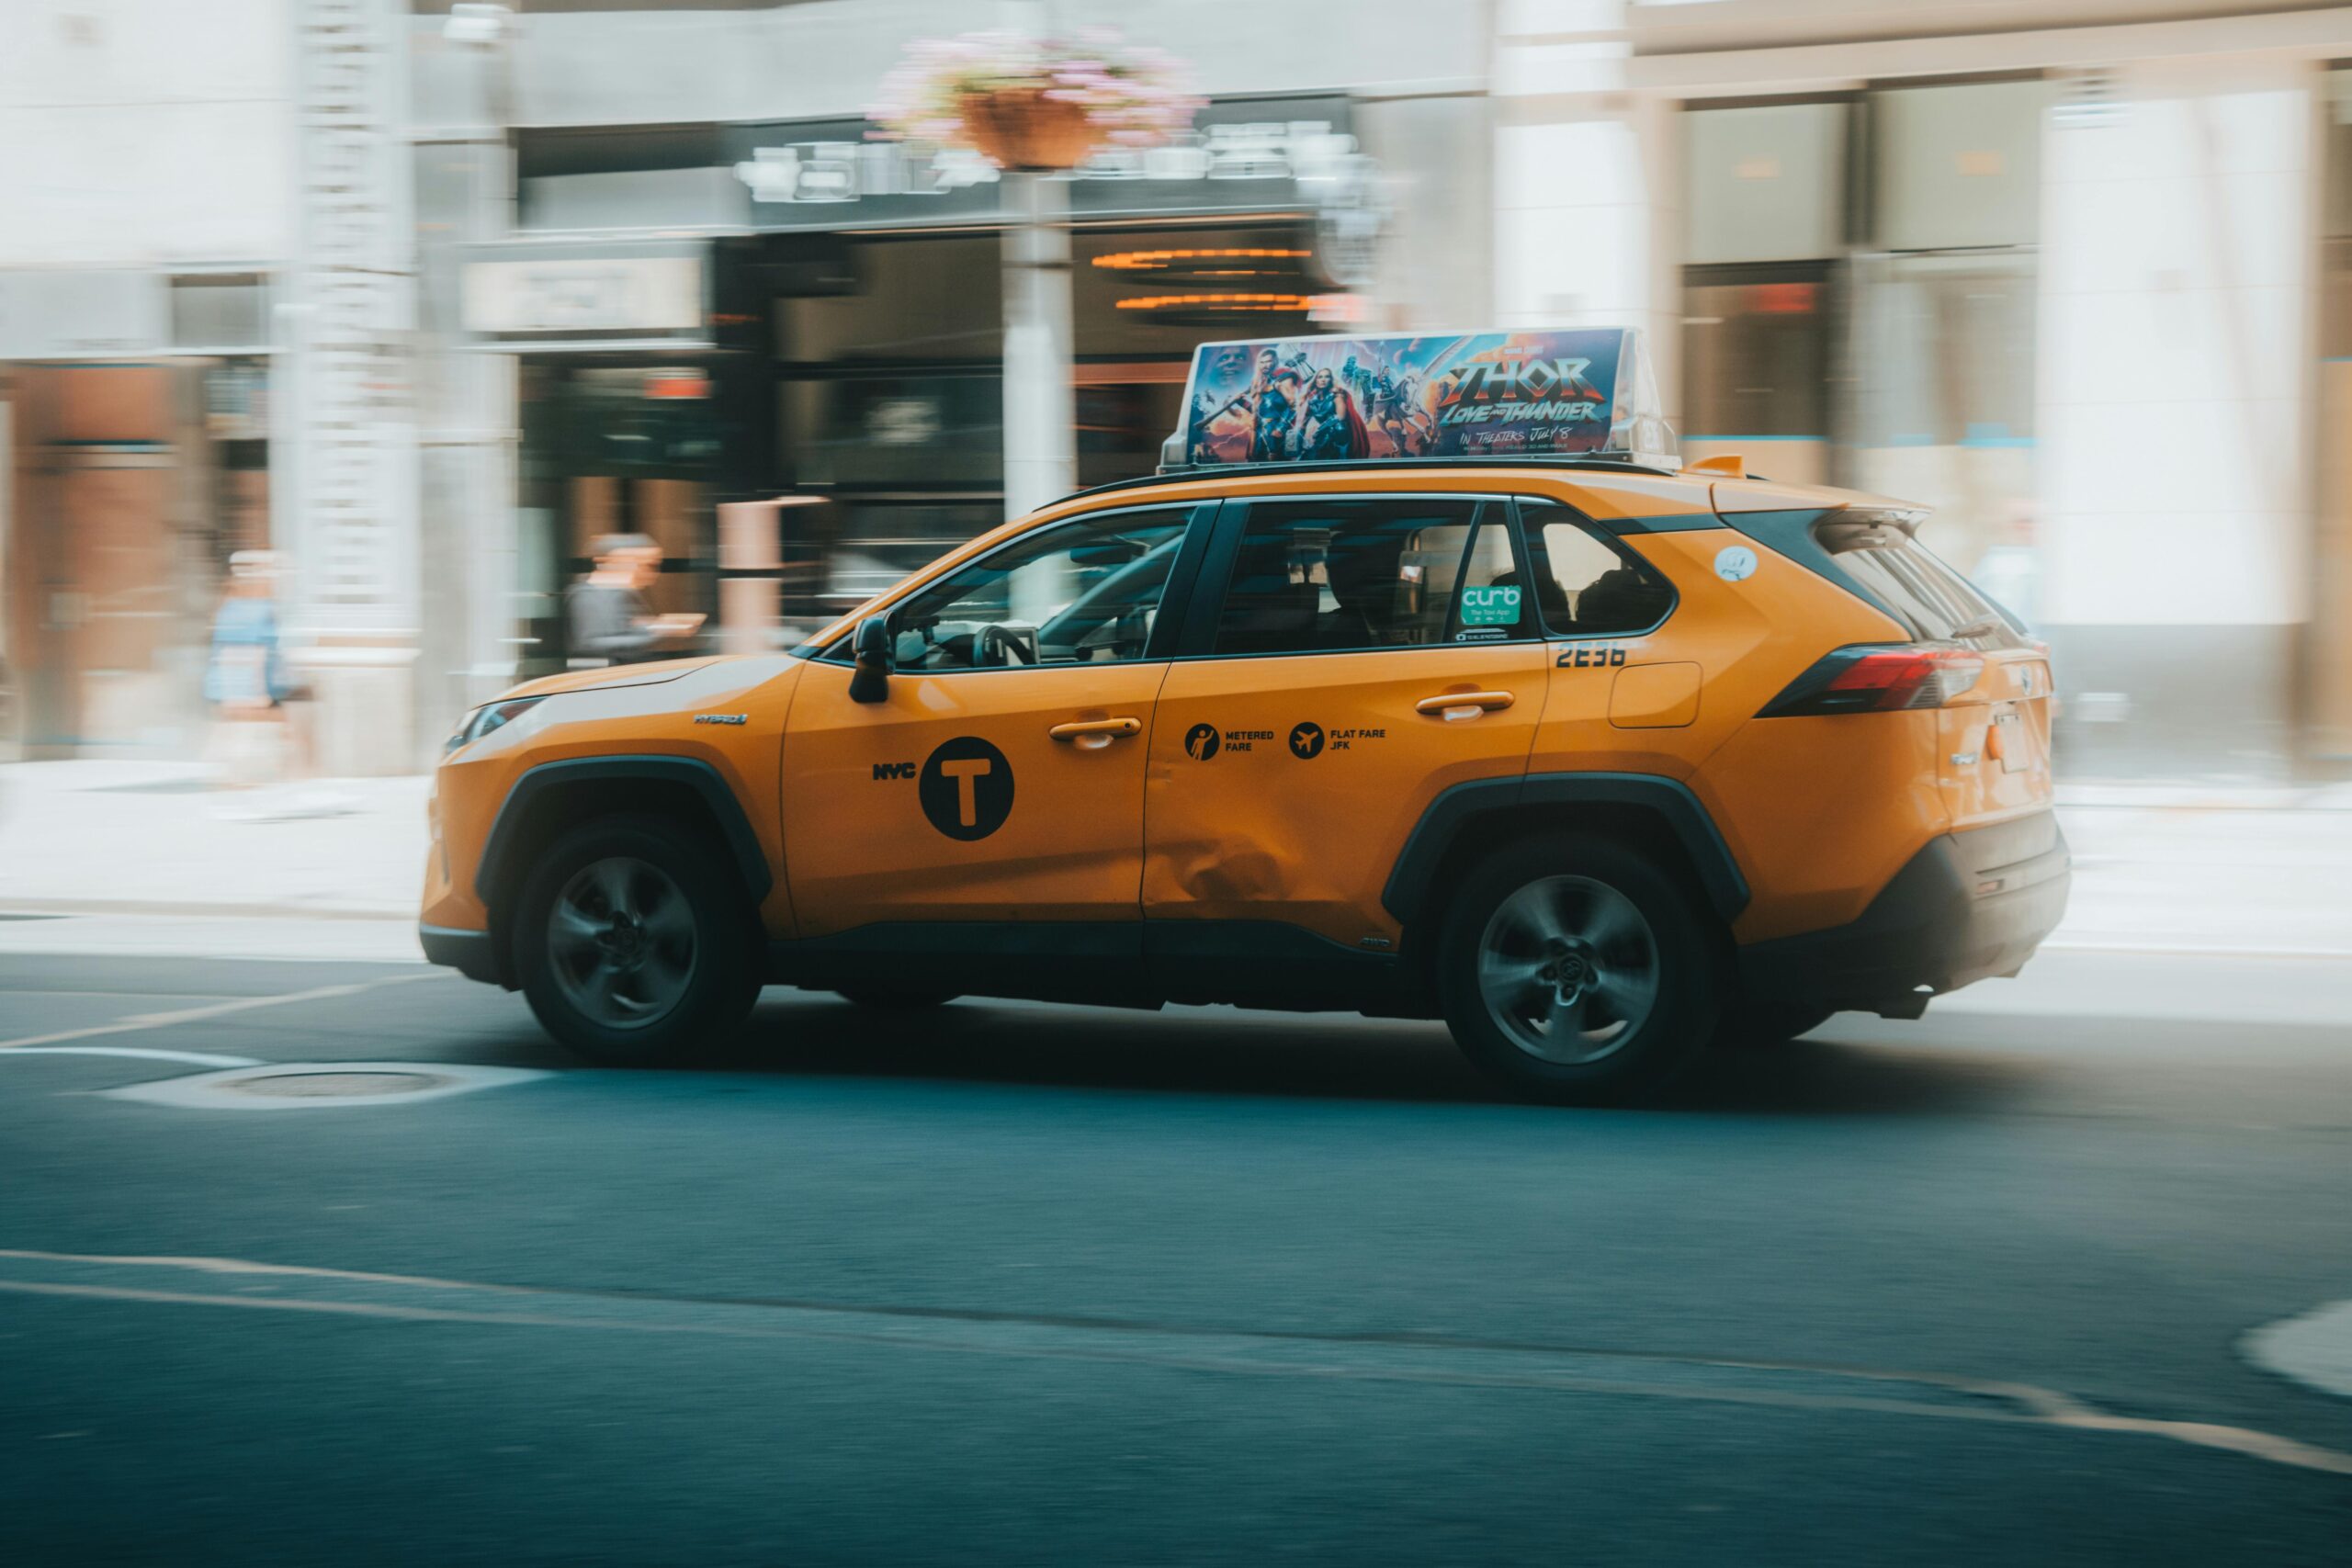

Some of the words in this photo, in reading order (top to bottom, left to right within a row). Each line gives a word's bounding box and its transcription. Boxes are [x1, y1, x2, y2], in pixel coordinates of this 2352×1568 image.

[1440, 357, 1605, 407] THOR
[1439, 403, 1492, 426] LOVE
[1495, 400, 1602, 426] THUNDER
[1459, 433, 1470, 445] IN
[1476, 430, 1525, 445] THEATERS
[1530, 425, 1558, 441] JULY
[1559, 426, 1573, 439] 8
[1463, 587, 1521, 606] curb
[1226, 730, 1274, 740] METERED
[1330, 729, 1357, 739] FLAT
[1359, 728, 1385, 738] FARE
[1226, 742, 1252, 751] FARE
[1330, 741, 1351, 750] JFK
[873, 762, 916, 780] NYC
[941, 758, 991, 827] T
